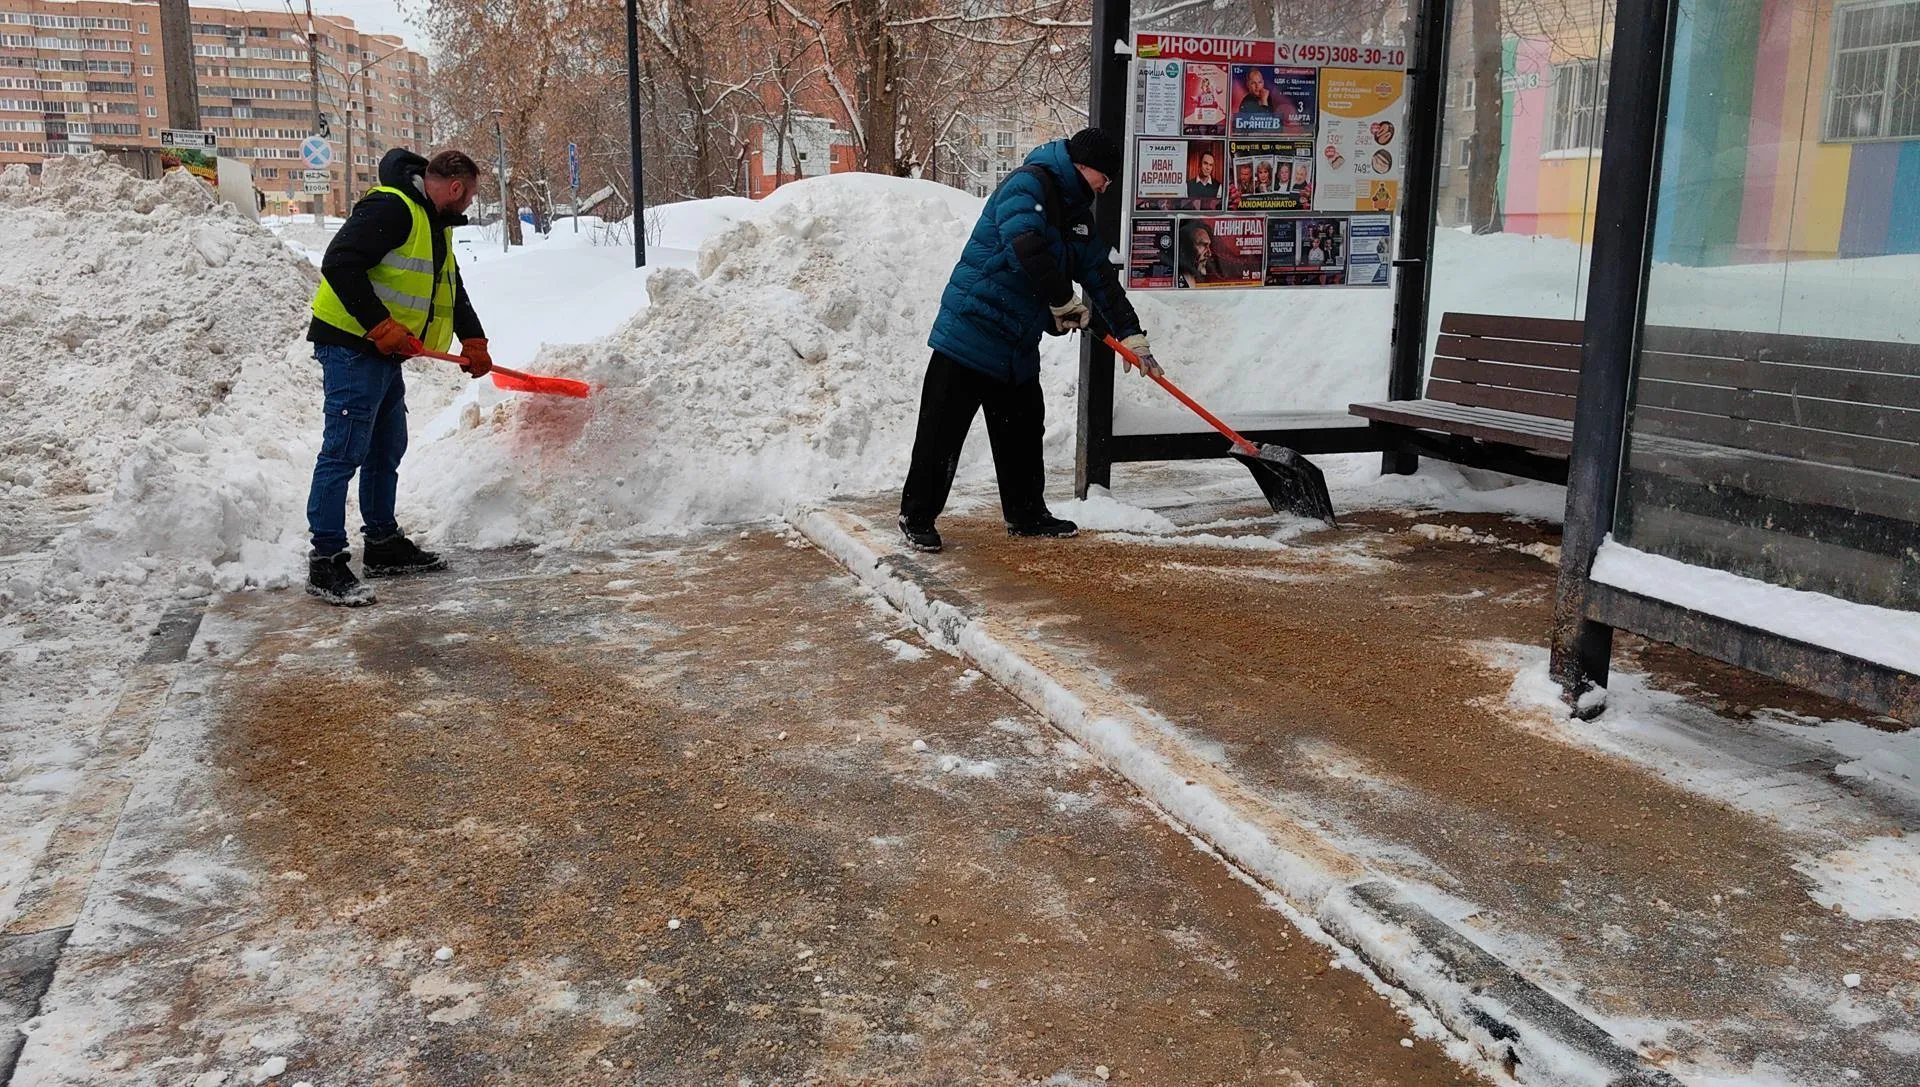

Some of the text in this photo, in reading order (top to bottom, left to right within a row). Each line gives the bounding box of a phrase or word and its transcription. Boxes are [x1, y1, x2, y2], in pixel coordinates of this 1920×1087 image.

[1158, 35, 1256, 59] ИНФОЩИТ
[1292, 43, 1405, 65] (495)308-30-10
[1298, 101, 1304, 112] 3
[1230, 142, 1236, 153] 9
[1152, 159, 1173, 171] ИВАН
[1141, 172, 1182, 184] АБРАМОВ
[1238, 200, 1297, 208] АККОМПАНИАТОР
[1214, 220, 1263, 236] ЛЕНИНГРАД
[1236, 238, 1244, 246] 26
